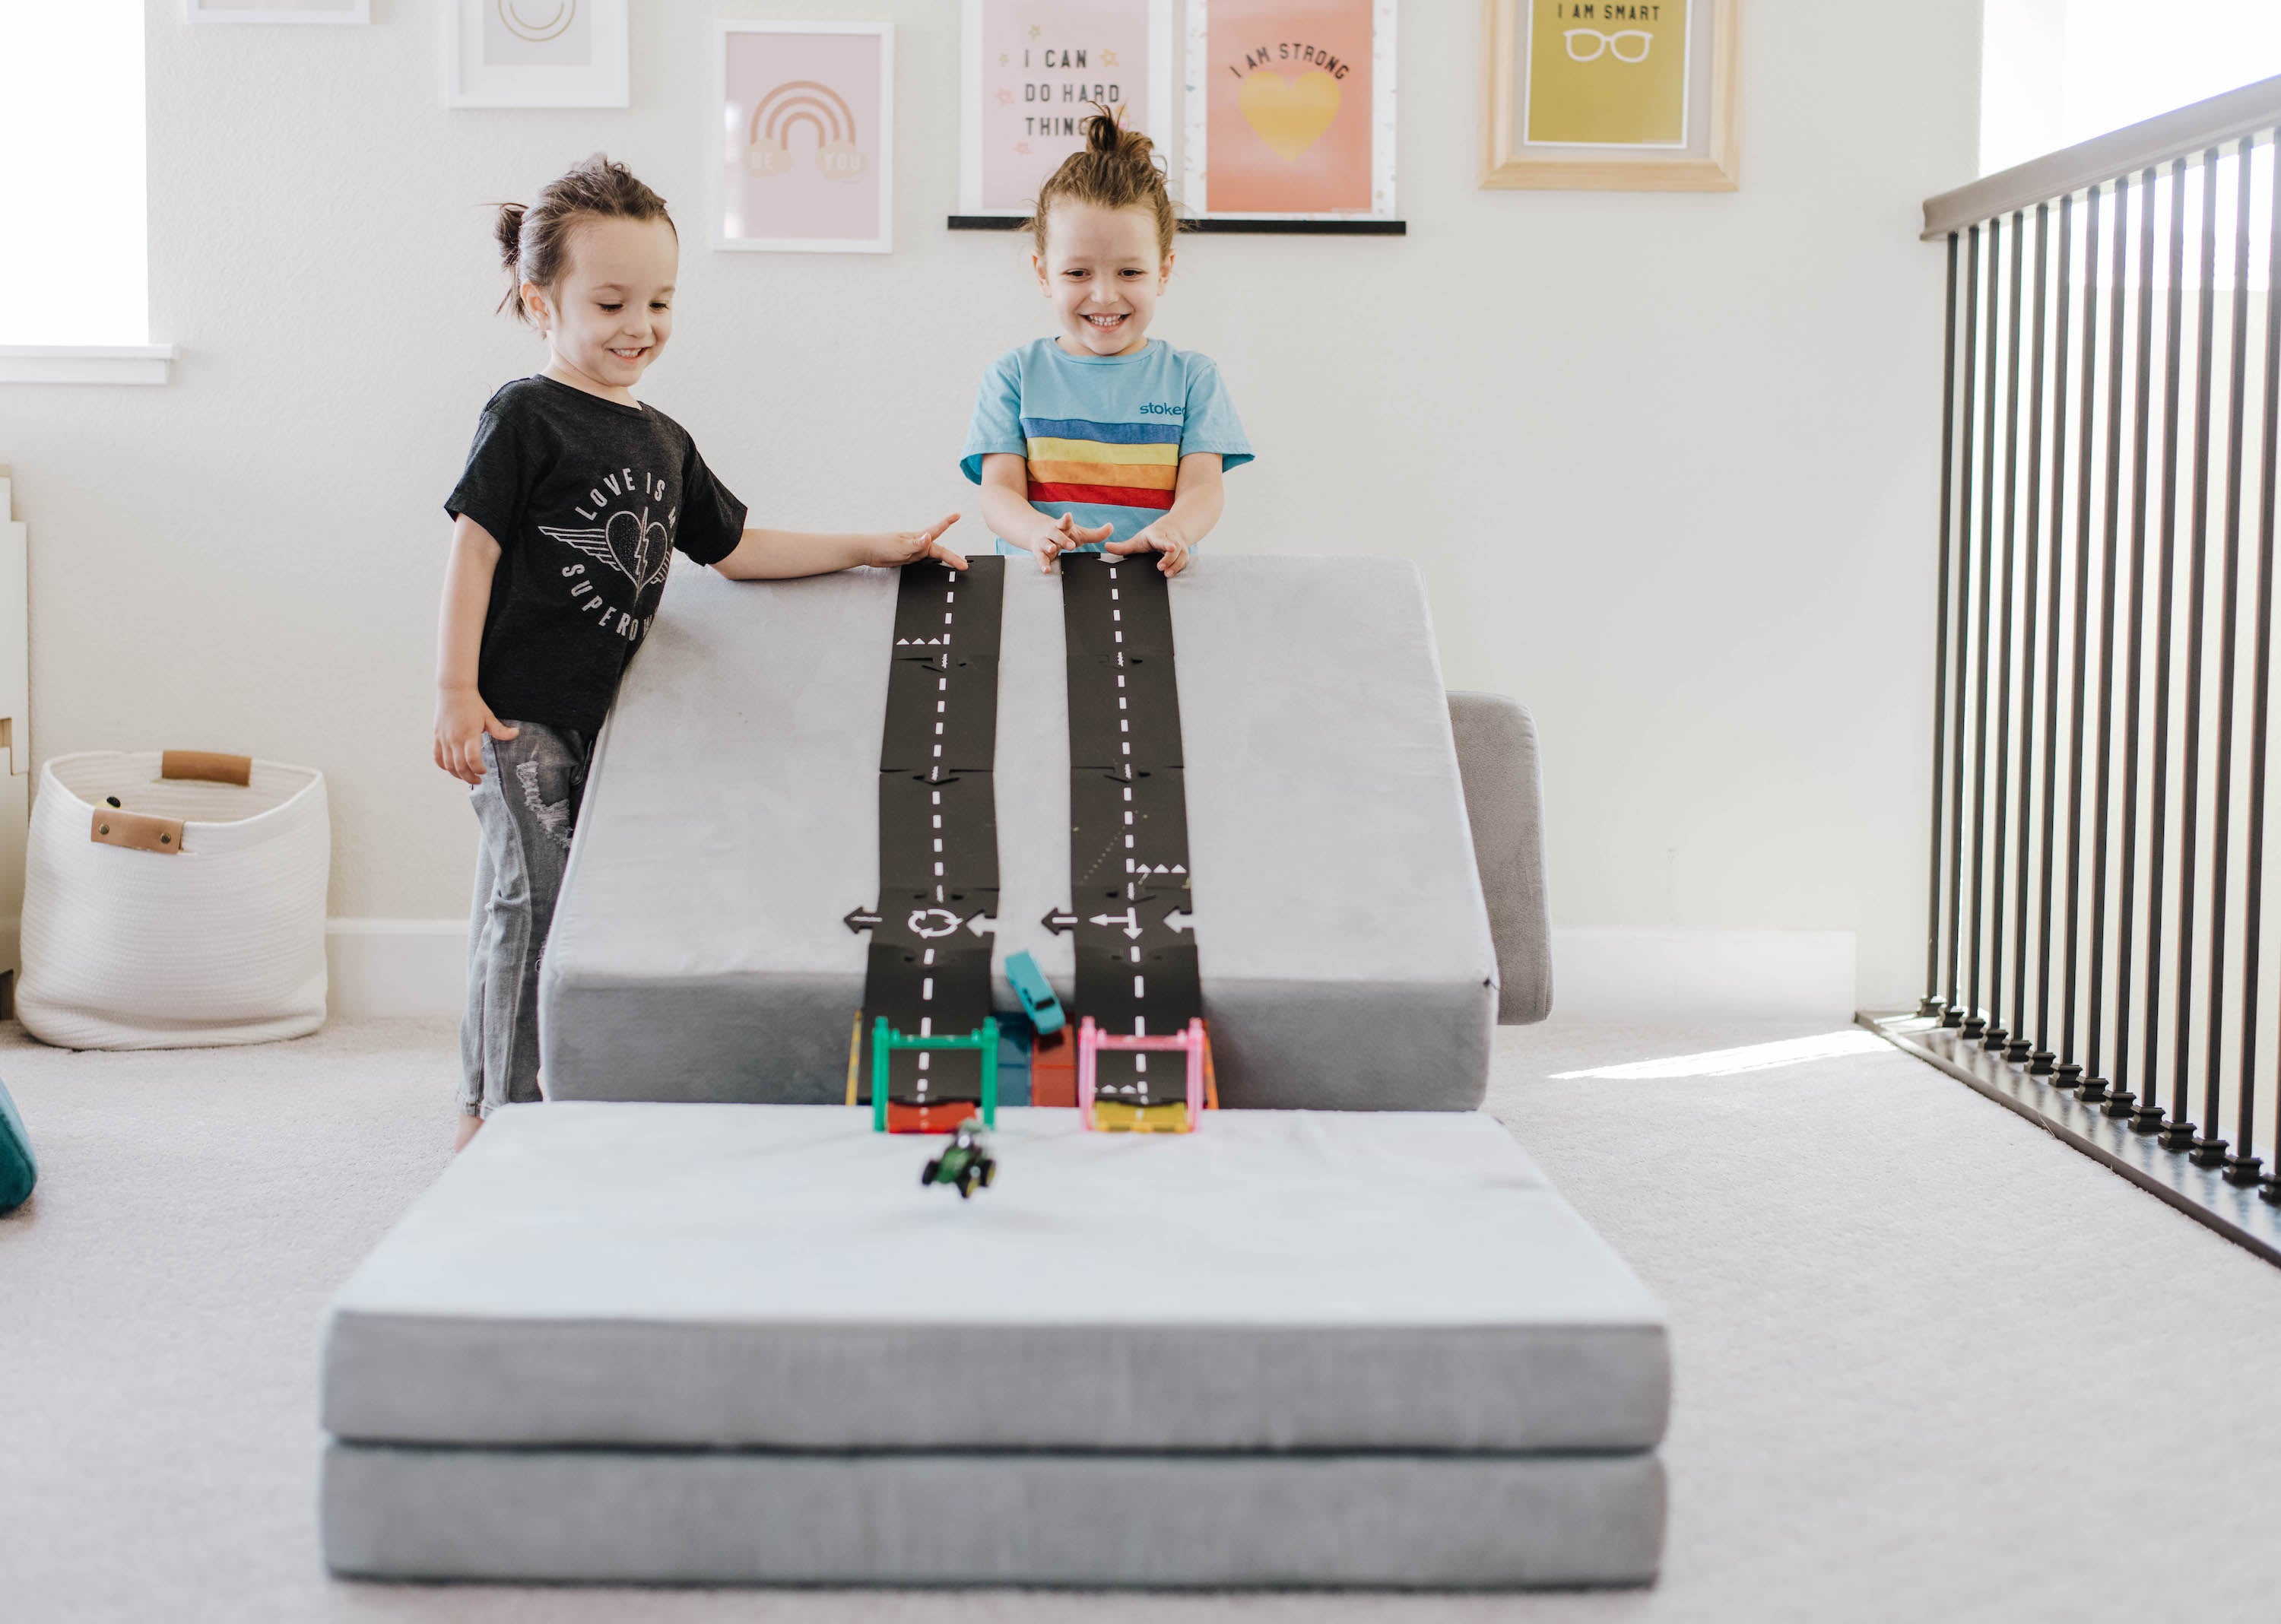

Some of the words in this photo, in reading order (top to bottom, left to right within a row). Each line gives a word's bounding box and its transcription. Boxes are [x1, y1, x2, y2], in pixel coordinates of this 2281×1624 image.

[1558, 5, 1562, 18] I
[1572, 5, 1594, 19] AM
[1604, 5, 1661, 21] SMART
[1024, 49, 1029, 68] I
[1045, 49, 1087, 68] CAN
[1229, 65, 1242, 79] I
[1245, 46, 1271, 70] AM
[1279, 43, 1350, 80] STRONG
[1025, 83, 1051, 103] DO
[1062, 84, 1120, 103] HARD
[751, 151, 773, 170] BE
[823, 153, 861, 171] YOU
[574, 468, 636, 521] LOVE
[646, 471, 666, 502] IS
